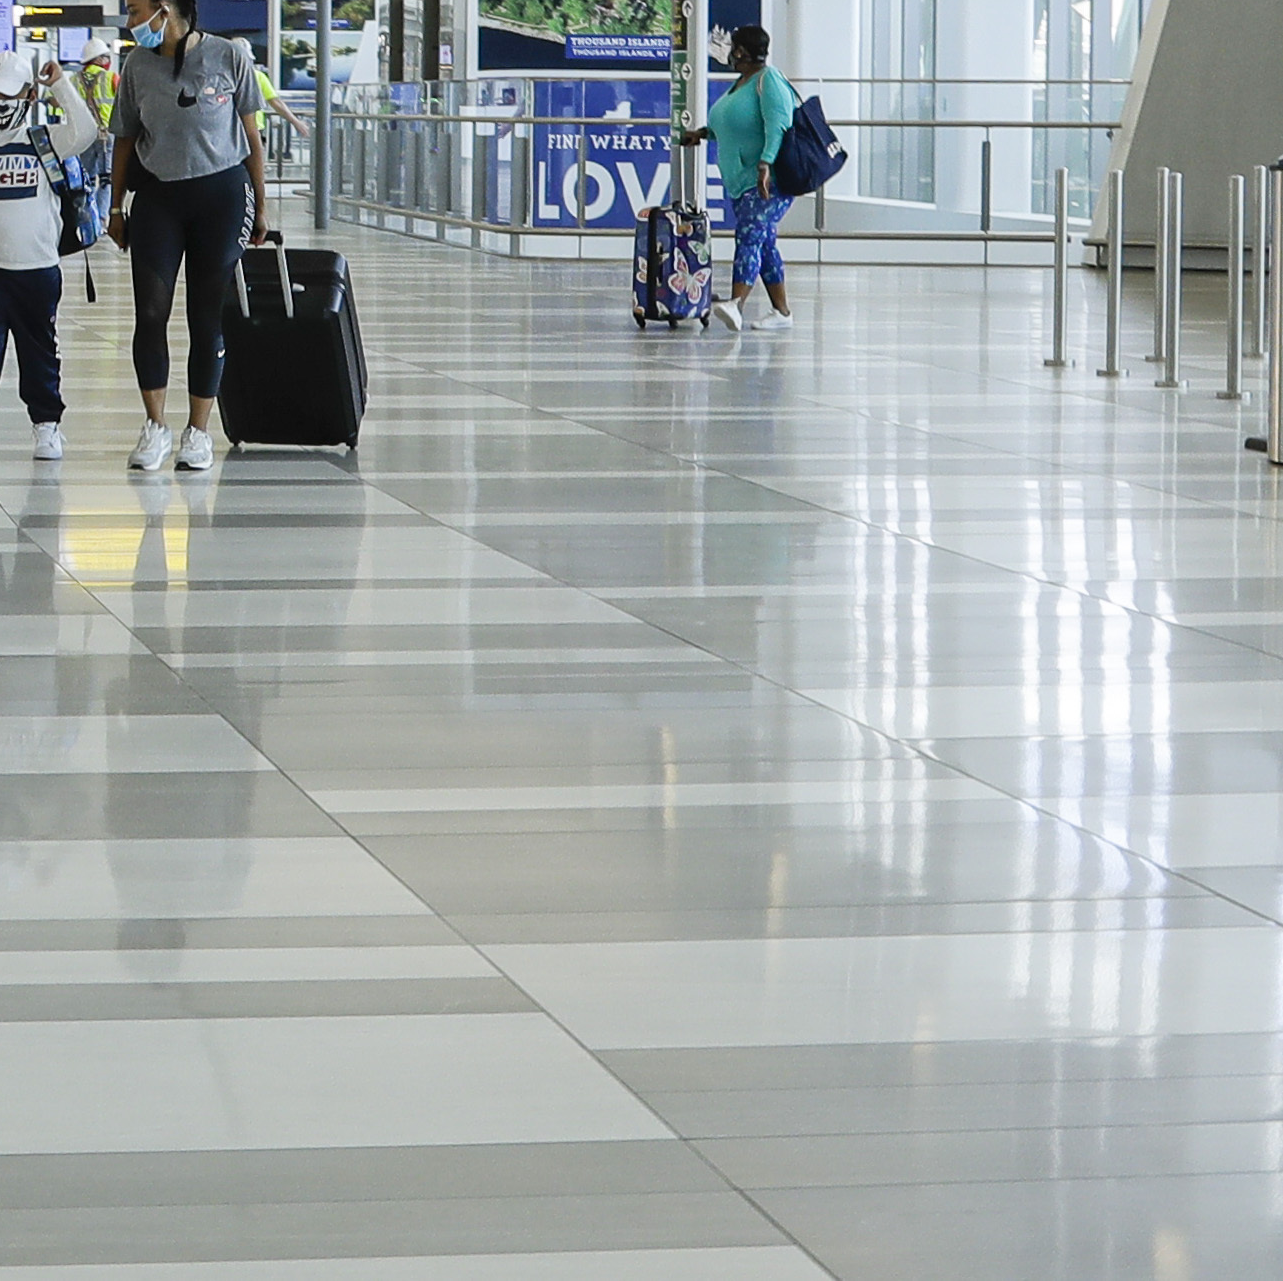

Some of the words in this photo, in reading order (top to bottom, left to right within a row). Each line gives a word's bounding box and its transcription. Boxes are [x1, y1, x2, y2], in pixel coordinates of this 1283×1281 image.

[570, 37, 626, 46] THOUSAND
[627, 37, 670, 47] ISLANDS
[572, 48, 617, 56] THOUSAND
[590, 134, 656, 150] WHAT
[538, 161, 725, 222] LOVE
